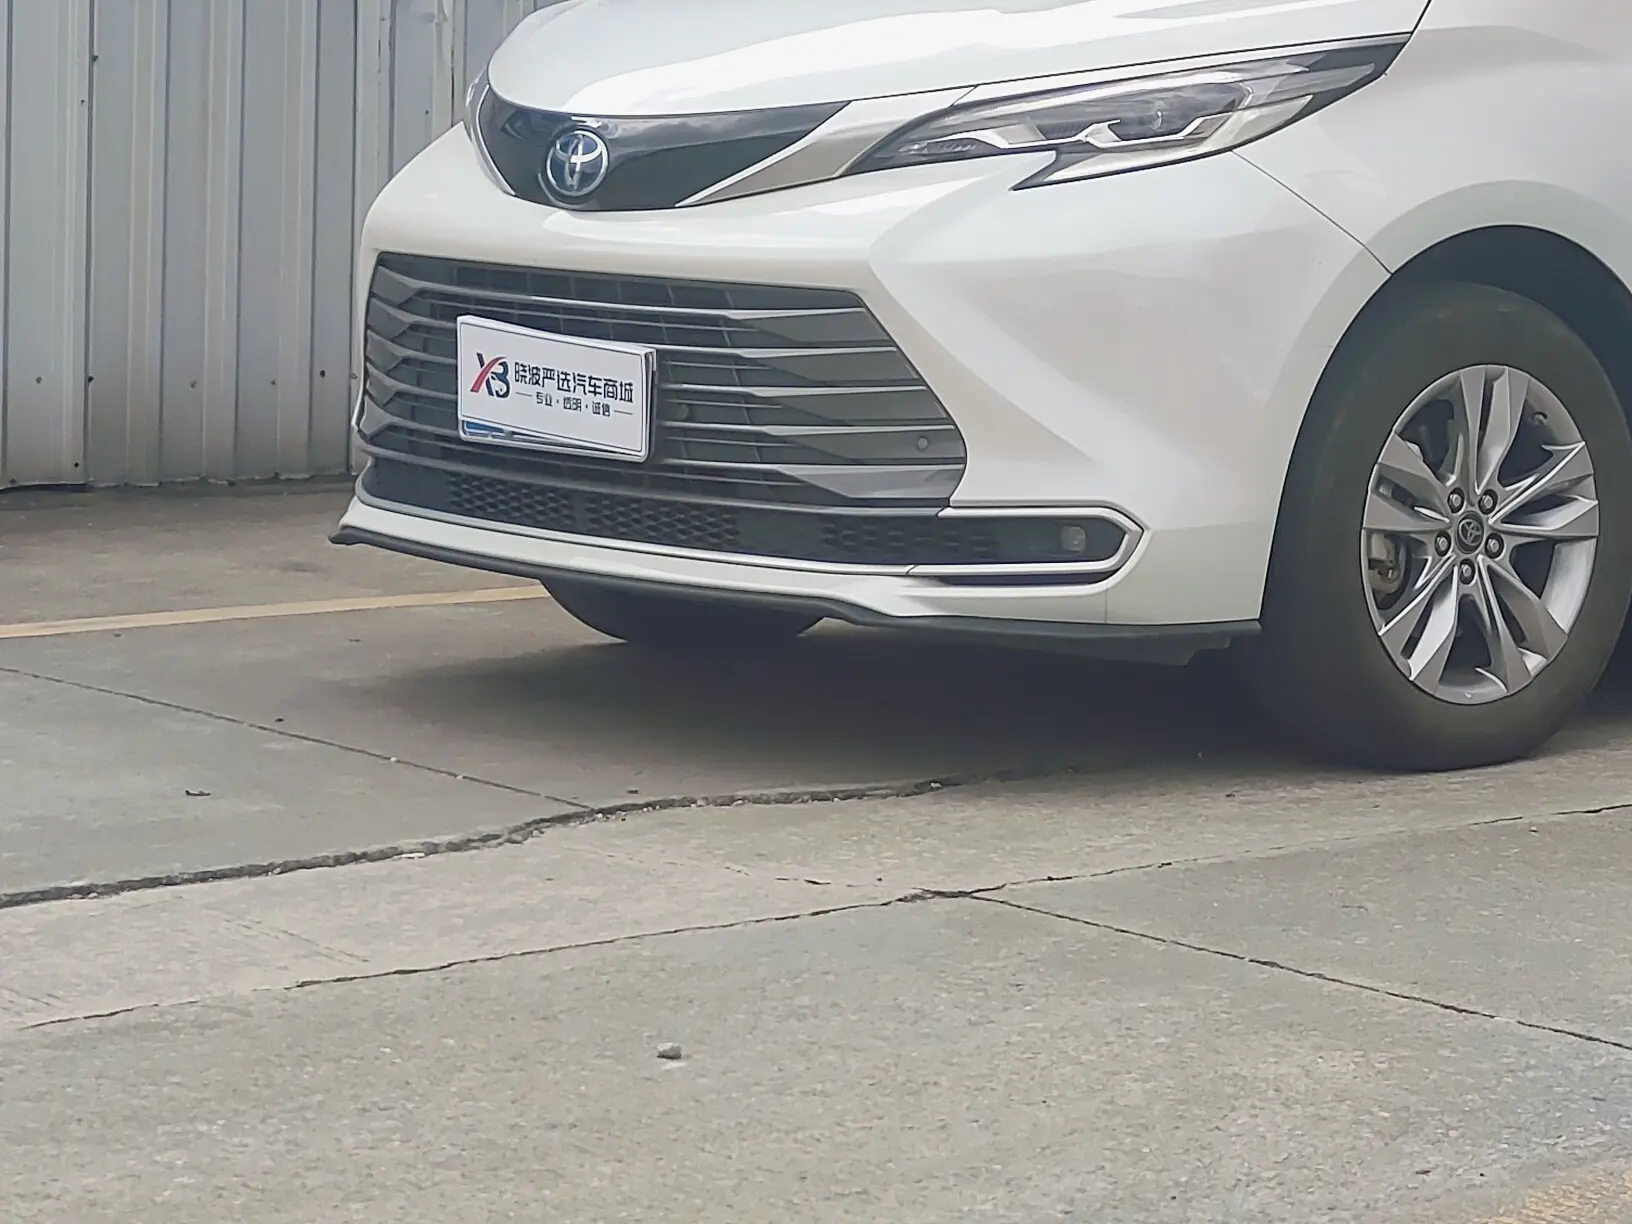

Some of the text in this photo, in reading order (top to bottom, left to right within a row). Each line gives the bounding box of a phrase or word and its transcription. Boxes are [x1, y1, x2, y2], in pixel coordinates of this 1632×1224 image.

[514, 361, 634, 403] 晓波严选汽车商城
